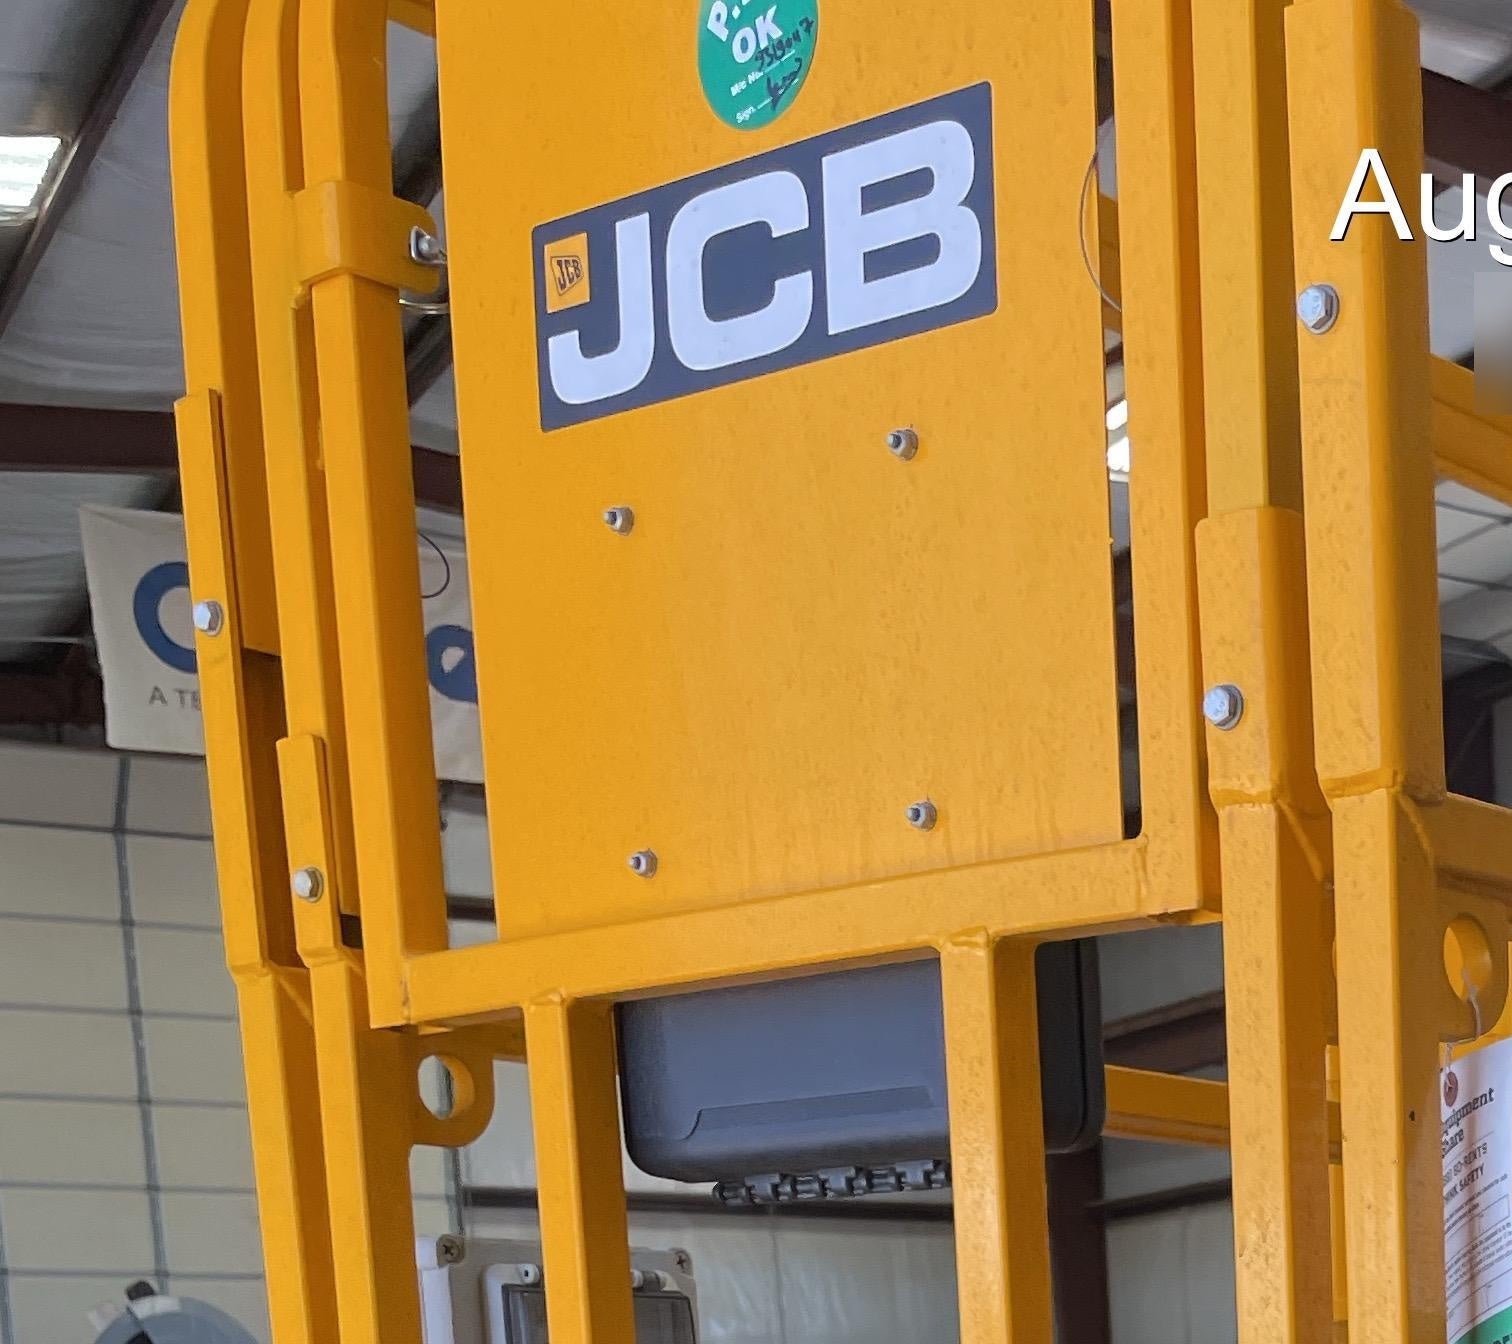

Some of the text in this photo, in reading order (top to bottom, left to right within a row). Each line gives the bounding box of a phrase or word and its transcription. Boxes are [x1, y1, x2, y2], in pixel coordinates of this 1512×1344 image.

[732, 5, 783, 63] OK
[548, 120, 983, 405] JCB
[556, 258, 582, 291] JCB
[1442, 1087, 1494, 1136] quipment
[1459, 1162, 1485, 1192] SAFETY
